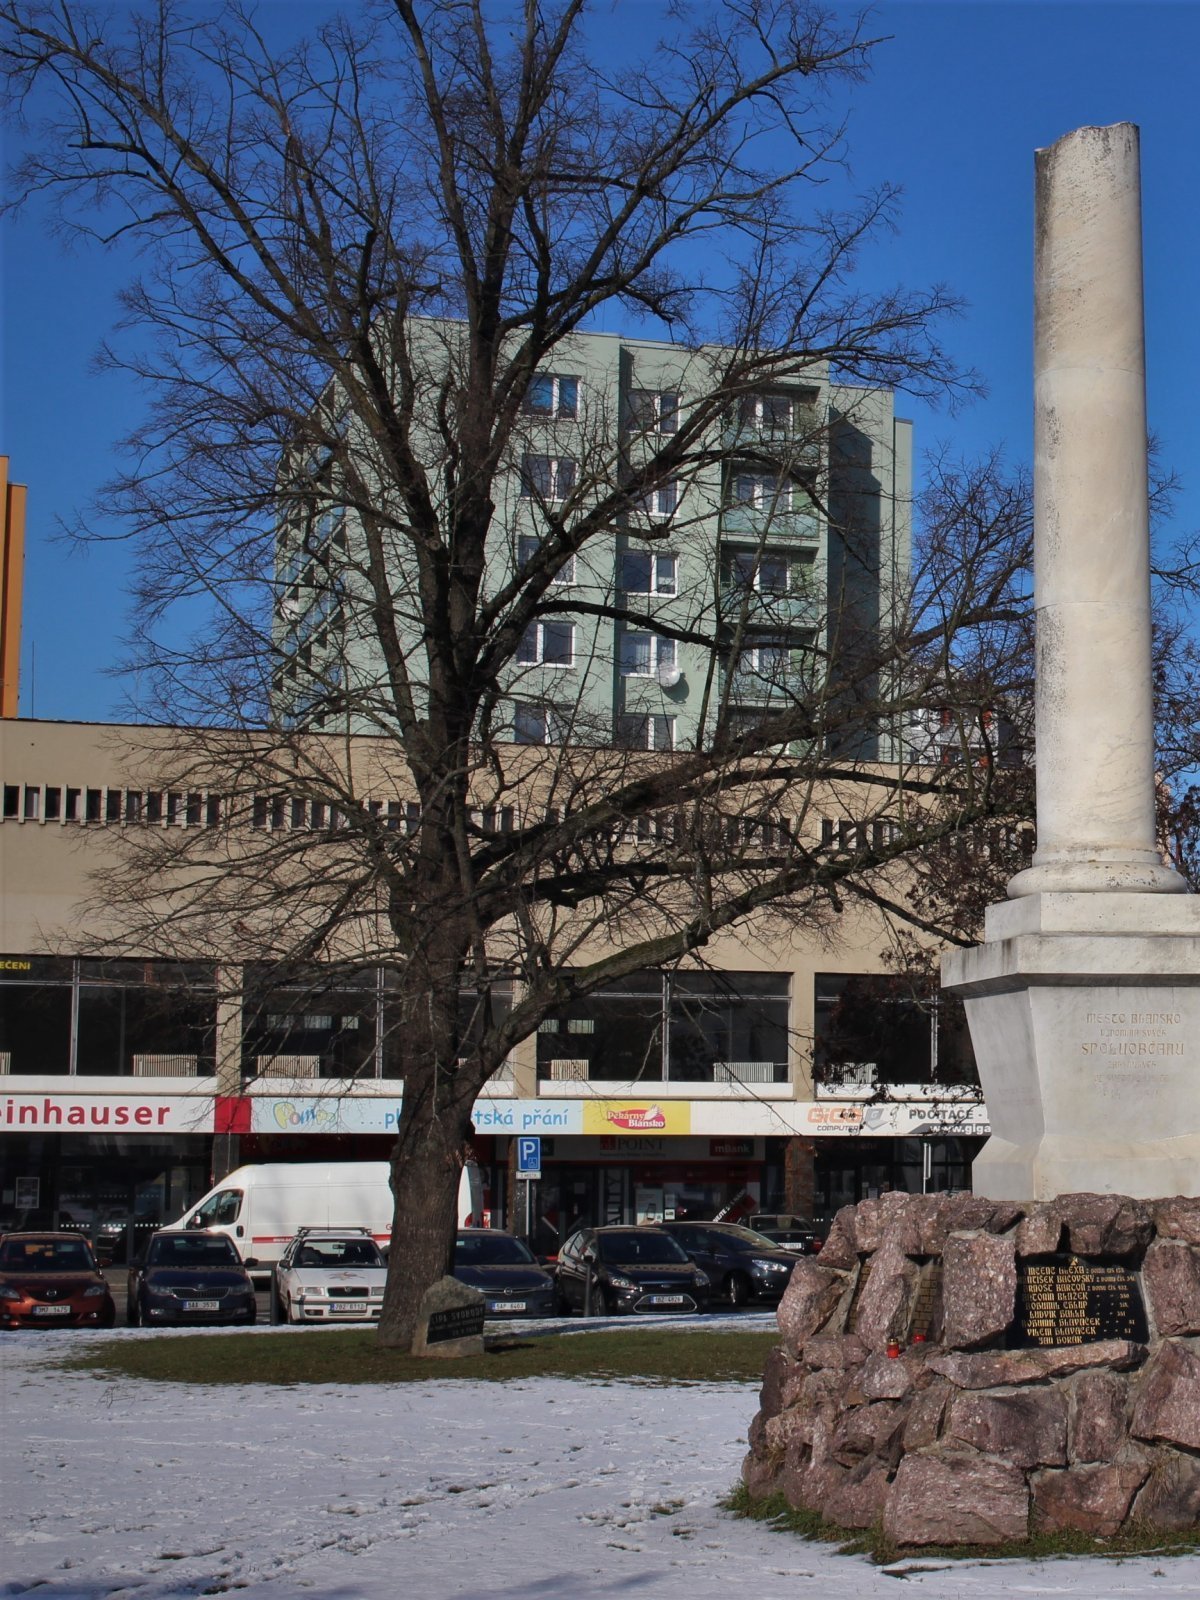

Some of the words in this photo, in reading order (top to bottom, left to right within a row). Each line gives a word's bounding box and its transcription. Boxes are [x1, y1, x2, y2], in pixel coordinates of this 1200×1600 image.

[0, 1099, 170, 1125] inhauser
[474, 1109, 514, 1125] tská
[521, 1109, 569, 1130] přání
[607, 1111, 645, 1123] Pekárny
[628, 1119, 666, 1128] Blansko
[523, 1141, 536, 1161] P
